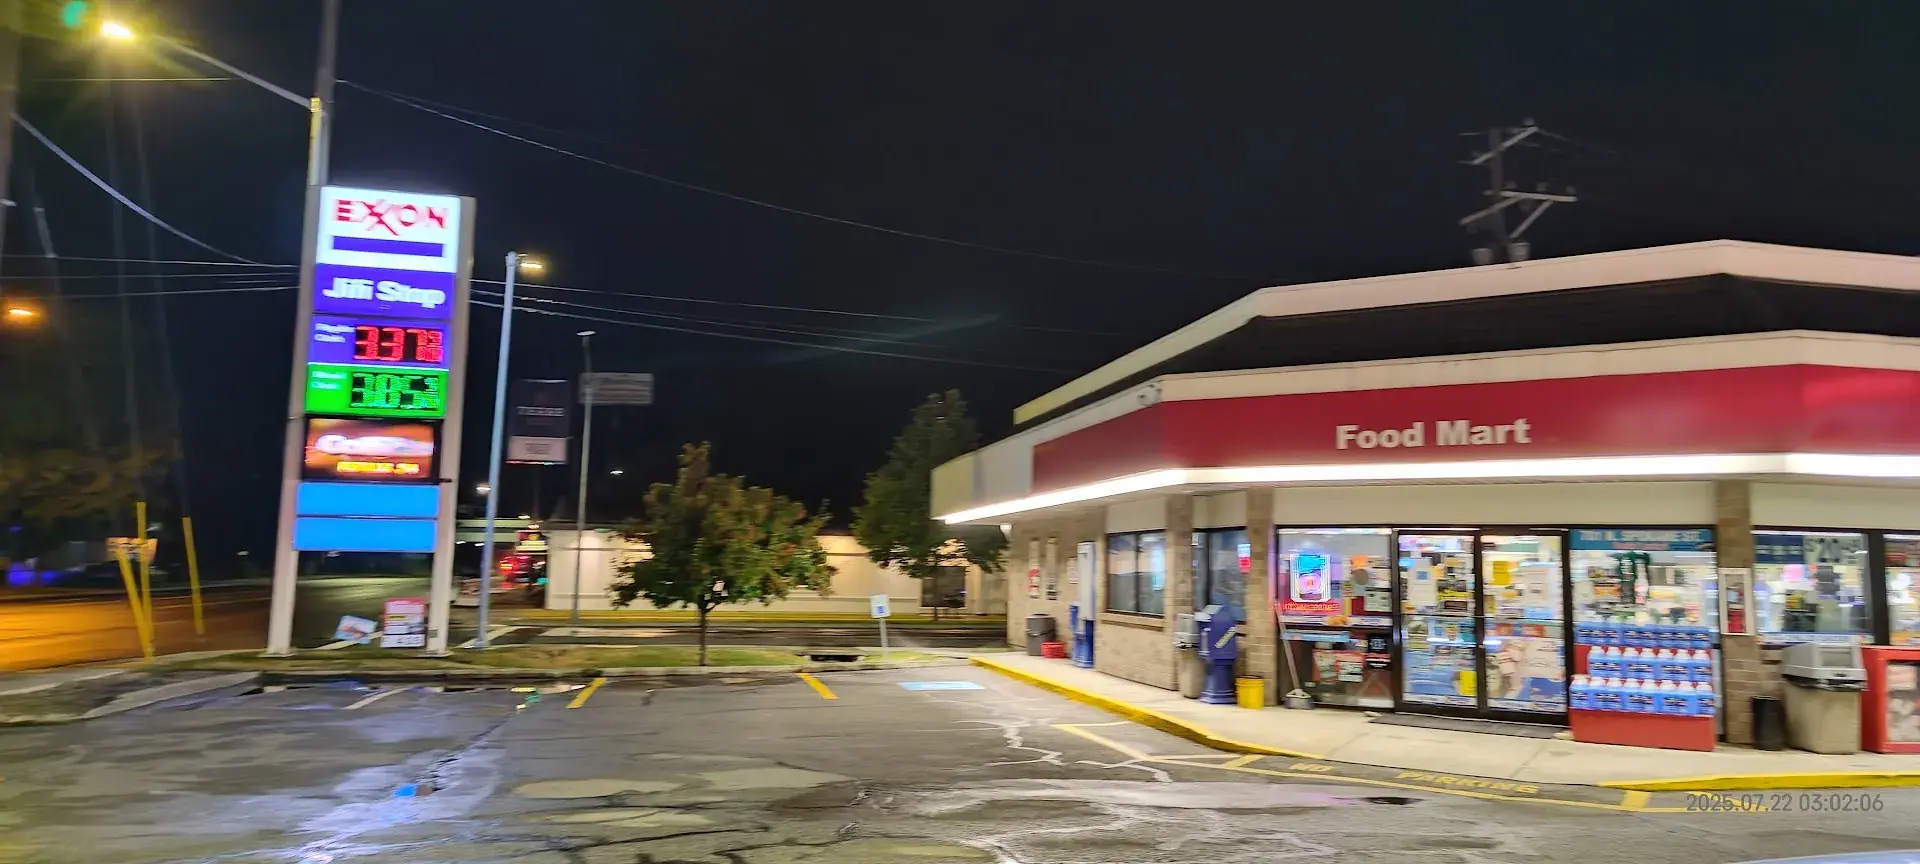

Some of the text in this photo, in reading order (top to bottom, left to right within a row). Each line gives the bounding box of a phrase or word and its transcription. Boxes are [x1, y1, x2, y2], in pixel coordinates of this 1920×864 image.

[334, 199, 448, 236] EXXON
[1336, 418, 1532, 449] Food Mart
[1394, 770, 1540, 794] PARKING
